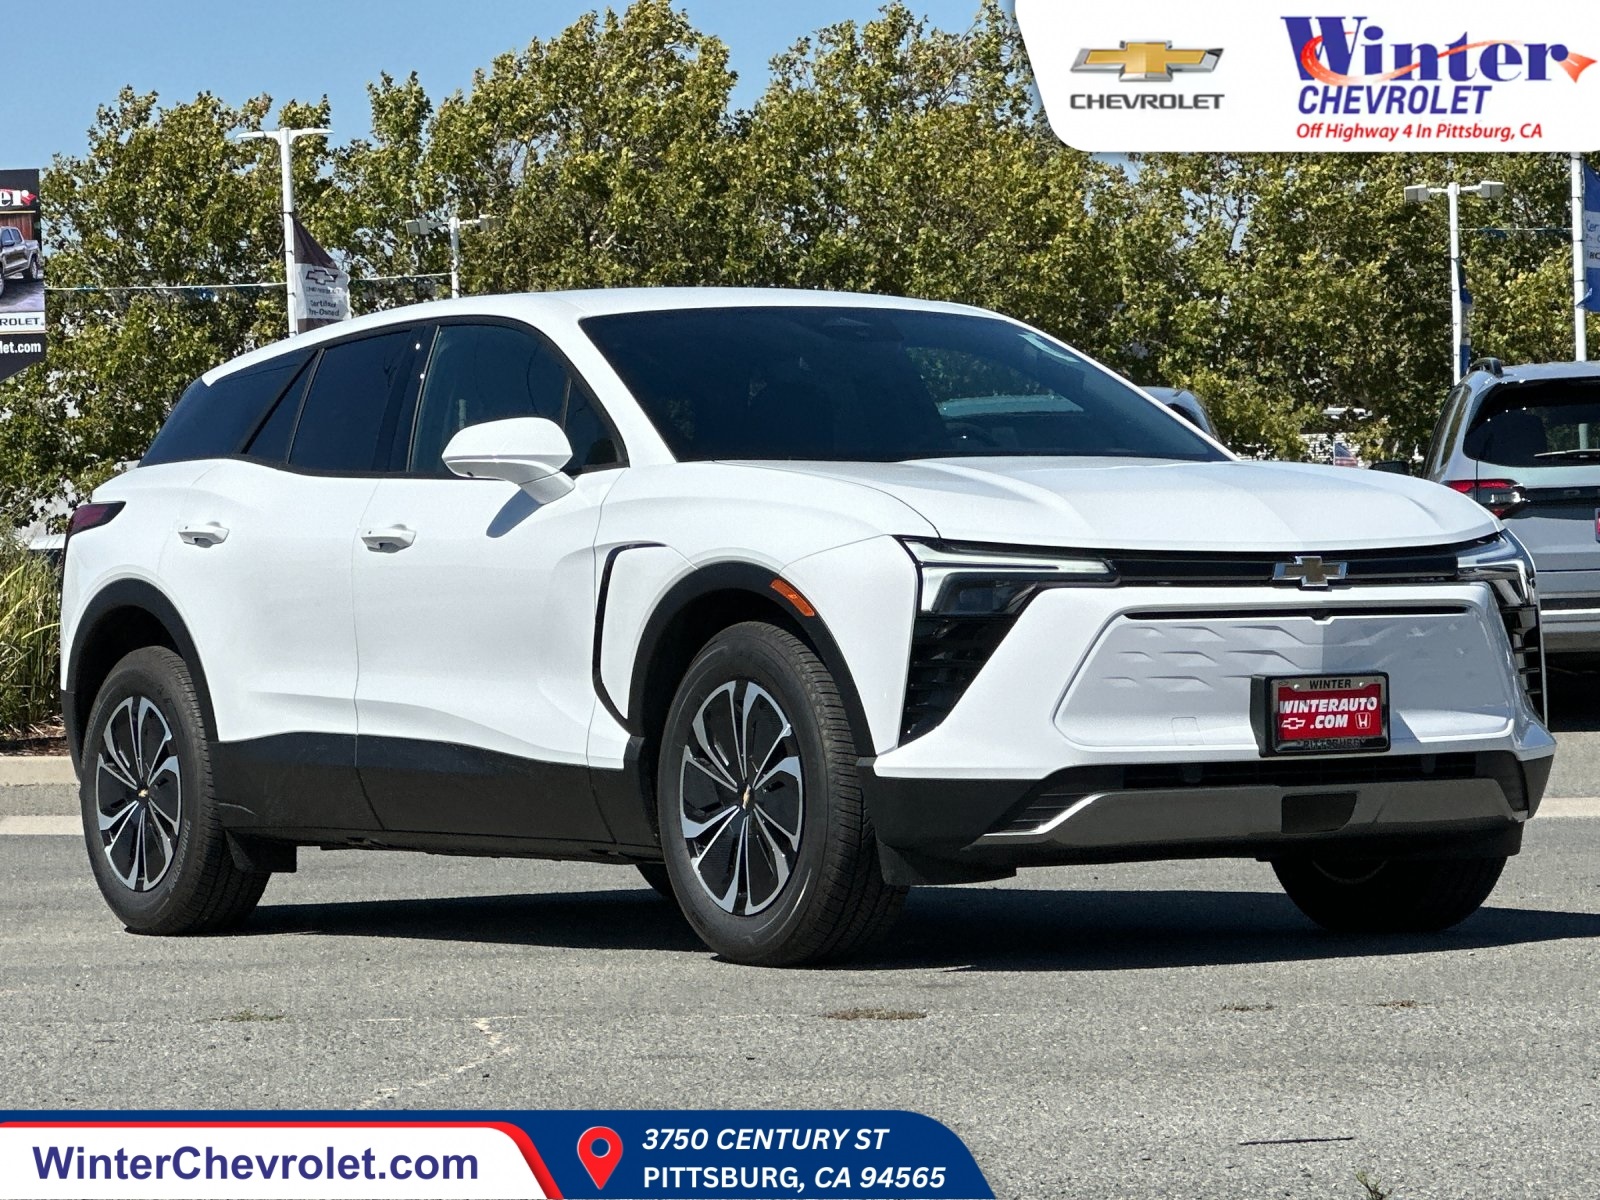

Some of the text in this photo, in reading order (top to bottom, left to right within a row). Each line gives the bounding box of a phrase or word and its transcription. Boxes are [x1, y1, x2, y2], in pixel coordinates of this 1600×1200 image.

[1309, 679, 1352, 690] WINTER
[1279, 697, 1378, 714] WINTERAUTO
[1309, 715, 1349, 730] .COM
